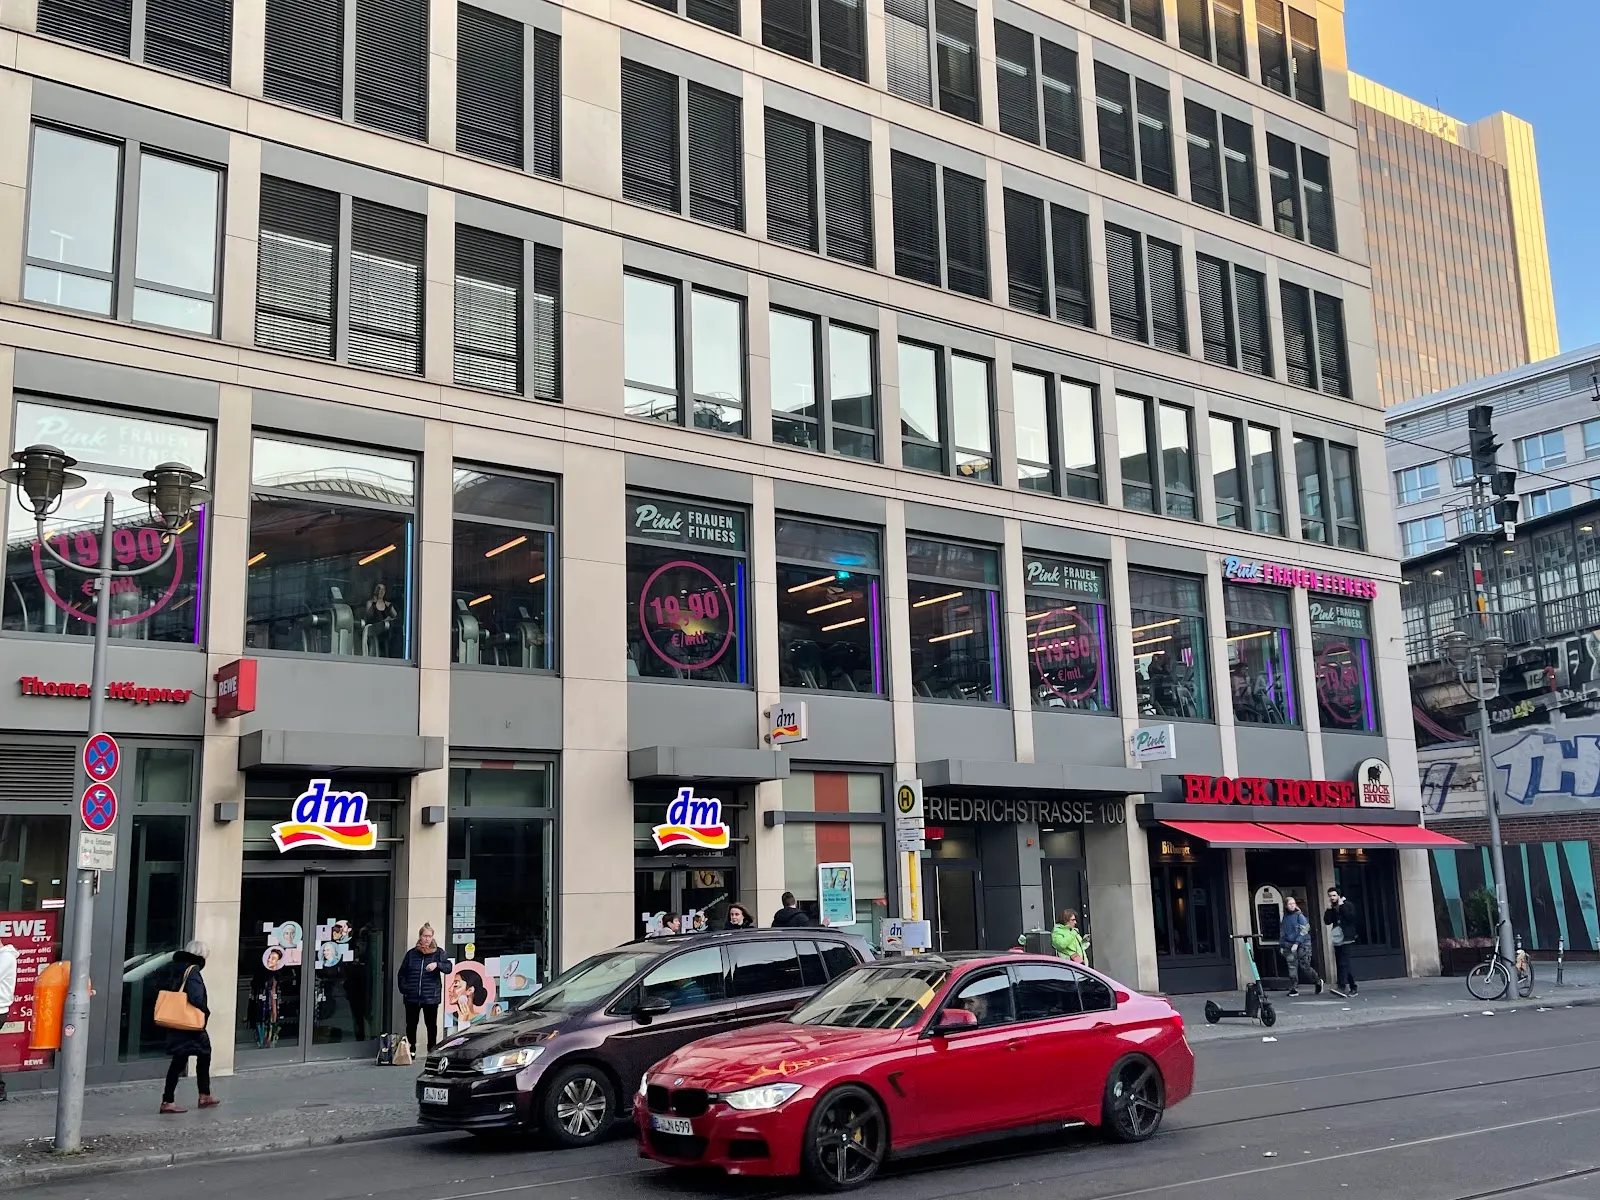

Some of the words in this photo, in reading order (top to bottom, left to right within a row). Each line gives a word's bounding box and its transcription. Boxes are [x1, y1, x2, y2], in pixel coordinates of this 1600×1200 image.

[35, 415, 108, 447] Pink
[119, 426, 189, 449] FRAUEN
[635, 504, 684, 531] Pink
[688, 511, 734, 530] FRAUEN
[688, 525, 736, 544] FITNESS
[51, 528, 162, 566] 1990
[1027, 561, 1060, 582] Pink
[1063, 566, 1097, 581] FRAUEN
[1225, 556, 1258, 579] Pink
[1262, 563, 1319, 590] FRAUEN
[1322, 574, 1378, 599] FITNESS
[81, 576, 141, 597] €mtl.
[1064, 578, 1099, 593] FITNESS
[650, 591, 720, 626] 19,90
[1310, 602, 1336, 621] Pink
[1336, 606, 1361, 618] FRAUEN
[1337, 616, 1363, 629] FITNESS
[20, 677, 92, 698] Thoma
[108, 681, 194, 704] Höppner
[218, 675, 238, 697] REWE
[776, 708, 795, 727] dm
[1136, 730, 1166, 750] Pink
[1183, 774, 1272, 806] BLOCK
[1273, 778, 1356, 808] HOUSE
[1363, 784, 1390, 794] BLOCK
[1363, 794, 1391, 804] HOUSE
[295, 783, 364, 824] dm
[669, 790, 719, 825] dm
[1099, 802, 1126, 824] 100
[0, 919, 47, 937] EWE
[17, 966, 36, 974] Berlin
[23, 1058, 44, 1066] REWE
[675, 1120, 691, 1134] 699
